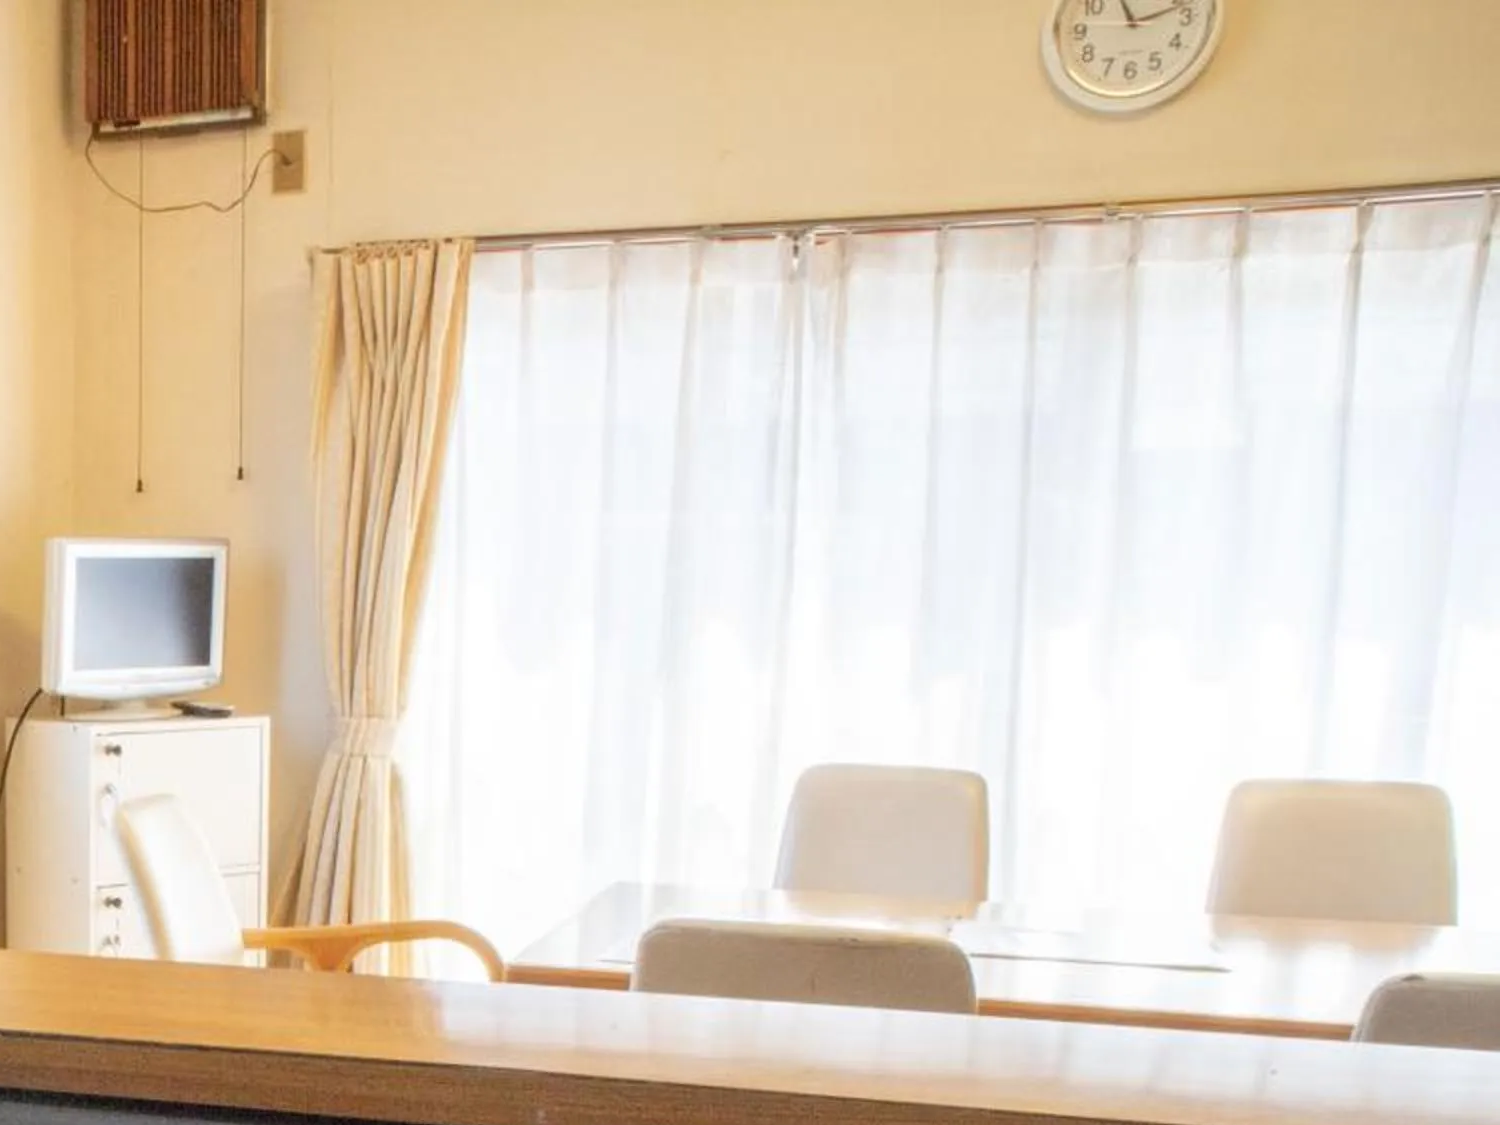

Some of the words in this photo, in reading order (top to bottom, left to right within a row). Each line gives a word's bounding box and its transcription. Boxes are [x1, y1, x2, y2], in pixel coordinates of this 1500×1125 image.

[1179, 7, 1193, 26] 3
[1073, 23, 1088, 40] 9
[1168, 33, 1182, 51] 4
[1081, 44, 1094, 63] 8
[1148, 52, 1162, 70] 5
[1101, 57, 1115, 77] 7
[1123, 61, 1137, 80] 6
